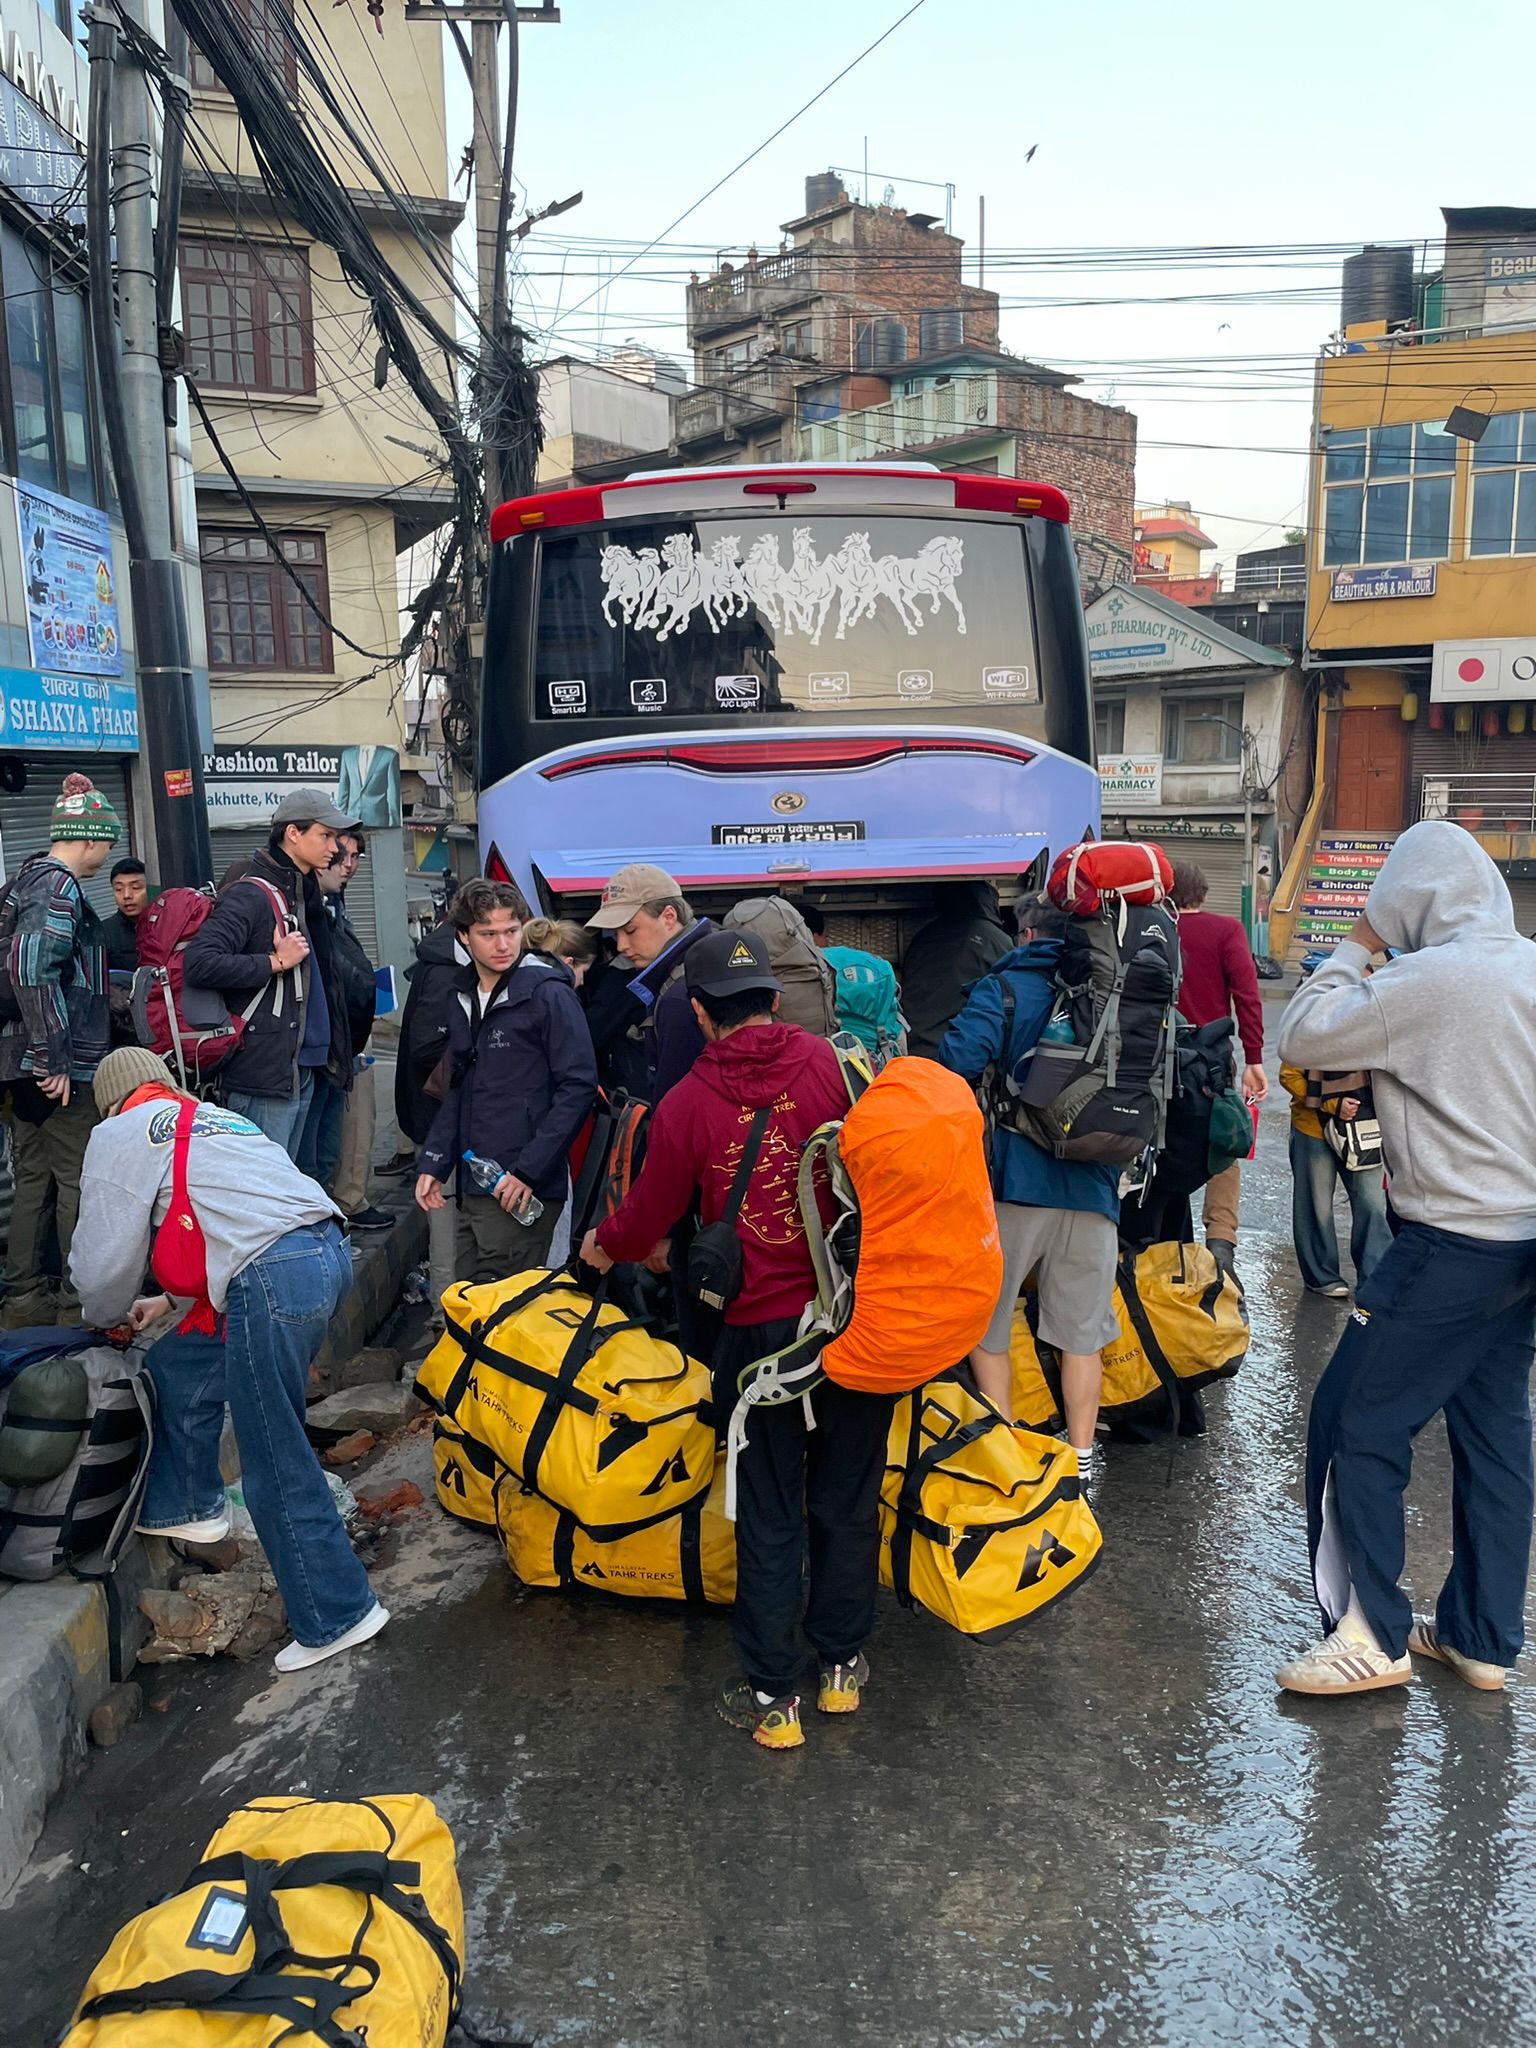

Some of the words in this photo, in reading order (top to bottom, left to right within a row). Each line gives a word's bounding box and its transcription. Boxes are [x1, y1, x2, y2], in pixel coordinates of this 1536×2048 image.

[0, 24, 87, 160] AKYA
[1335, 583, 1373, 598] BEAUTIFUL
[1375, 582, 1388, 596] SPA
[1390, 581, 1396, 595] &
[1398, 579, 1431, 594] PARLOUR
[1088, 623, 1108, 639] MEL
[1111, 619, 1167, 638] PHARMACY
[1167, 627, 1188, 647] PVT.
[1190, 637, 1212, 660] LTD.
[41, 676, 80, 698] शाक्य
[1007, 691, 1027, 699] Zone
[552, 707, 572, 715] Smart
[573, 705, 587, 714] Led
[638, 704, 663, 713] Music
[736, 699, 756, 709] Light
[10, 698, 89, 734] SHAKYA
[203, 751, 279, 773] Fashion
[283, 751, 339, 773] Tailor
[1135, 765, 1156, 775] WAY
[207, 792, 262, 807] akhutte,
[1334, 842, 1348, 850] Spa
[1329, 868, 1358, 876] Body
[1334, 895, 1355, 905] Body
[1311, 922, 1325, 930] Spa
[773, 1101, 797, 1114] TREK
[1113, 1347, 1140, 1365] TREKS
[609, 1569, 638, 1579] TAHR
[639, 1571, 675, 1581] TREKS
